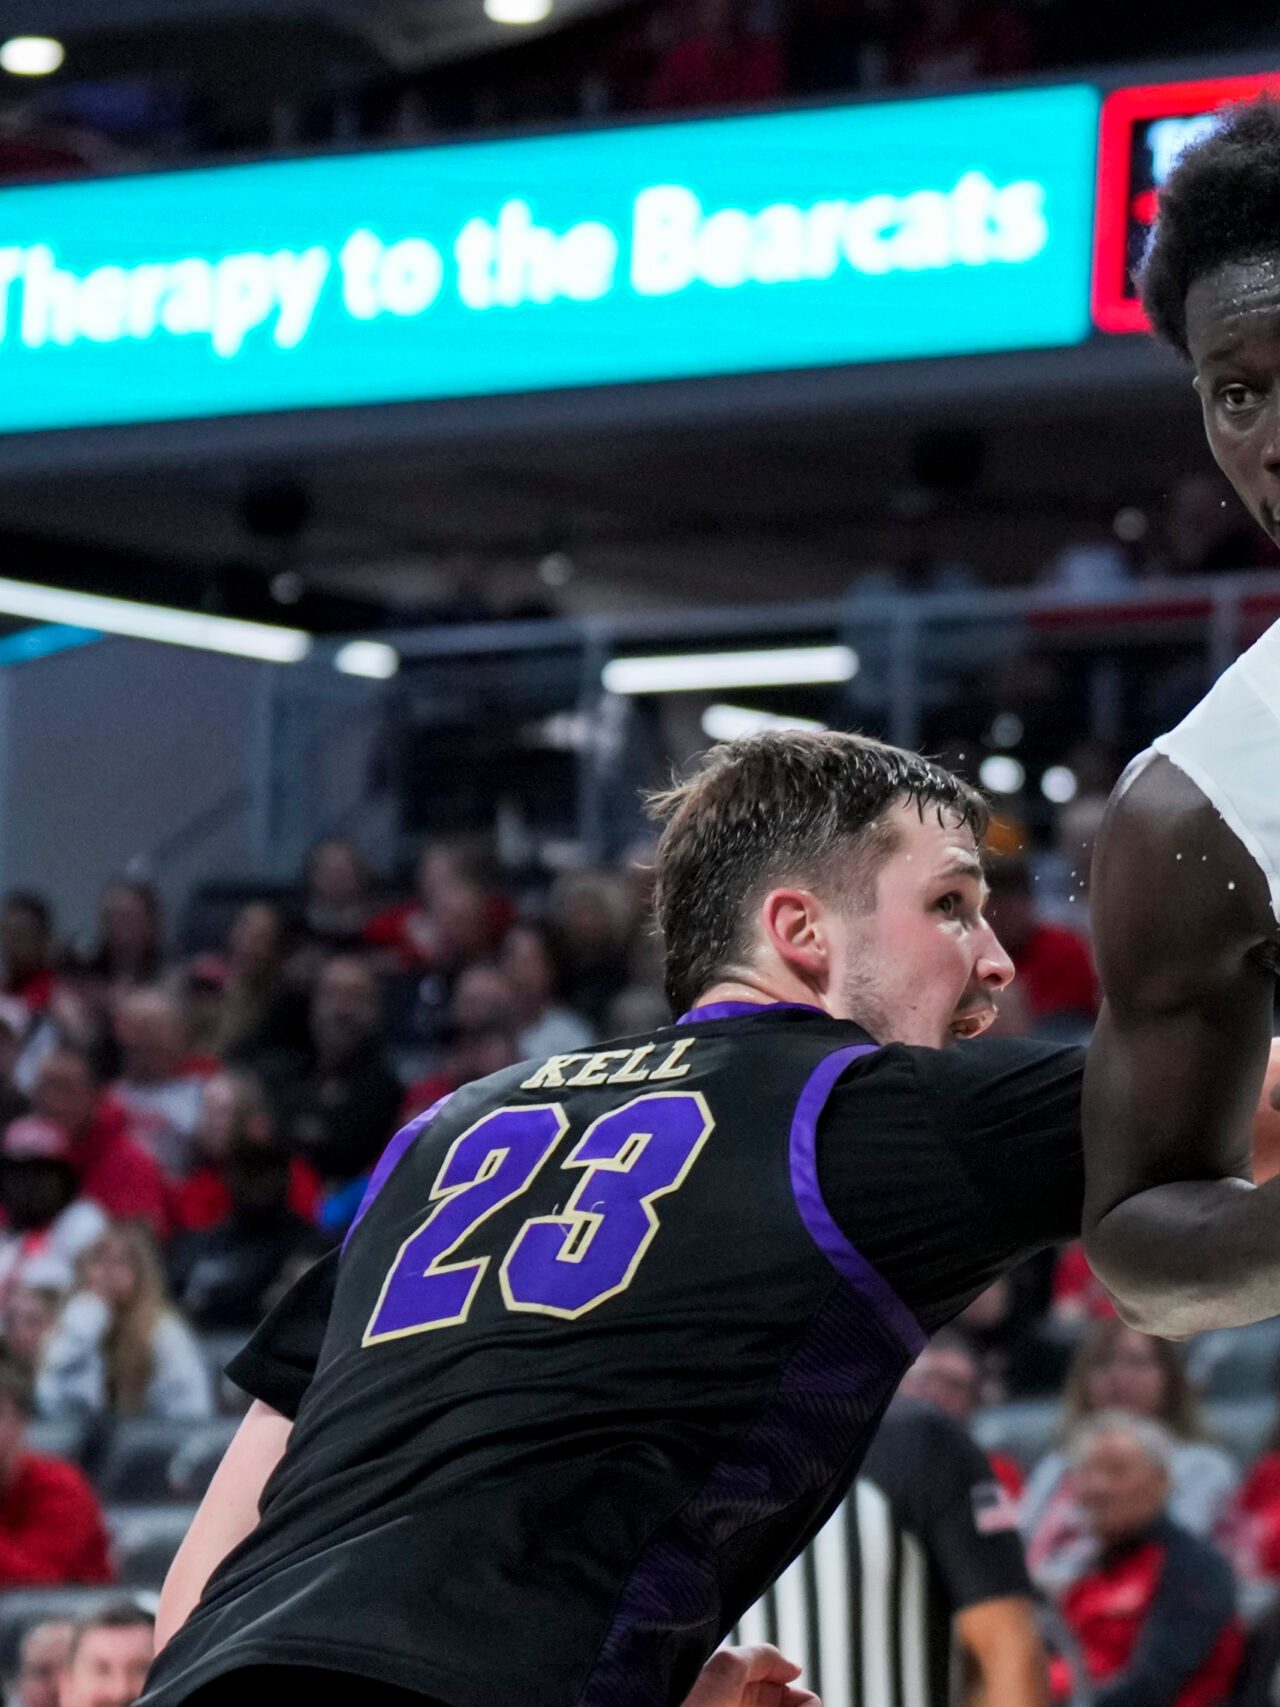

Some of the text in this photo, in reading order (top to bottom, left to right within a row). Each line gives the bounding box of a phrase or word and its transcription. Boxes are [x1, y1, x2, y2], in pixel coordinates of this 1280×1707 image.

[340, 227, 443, 320] to
[455, 198, 617, 309] the
[630, 169, 1048, 296] Bearcats
[520, 1038, 696, 1088] KELL
[361, 1091, 716, 1348] 23
